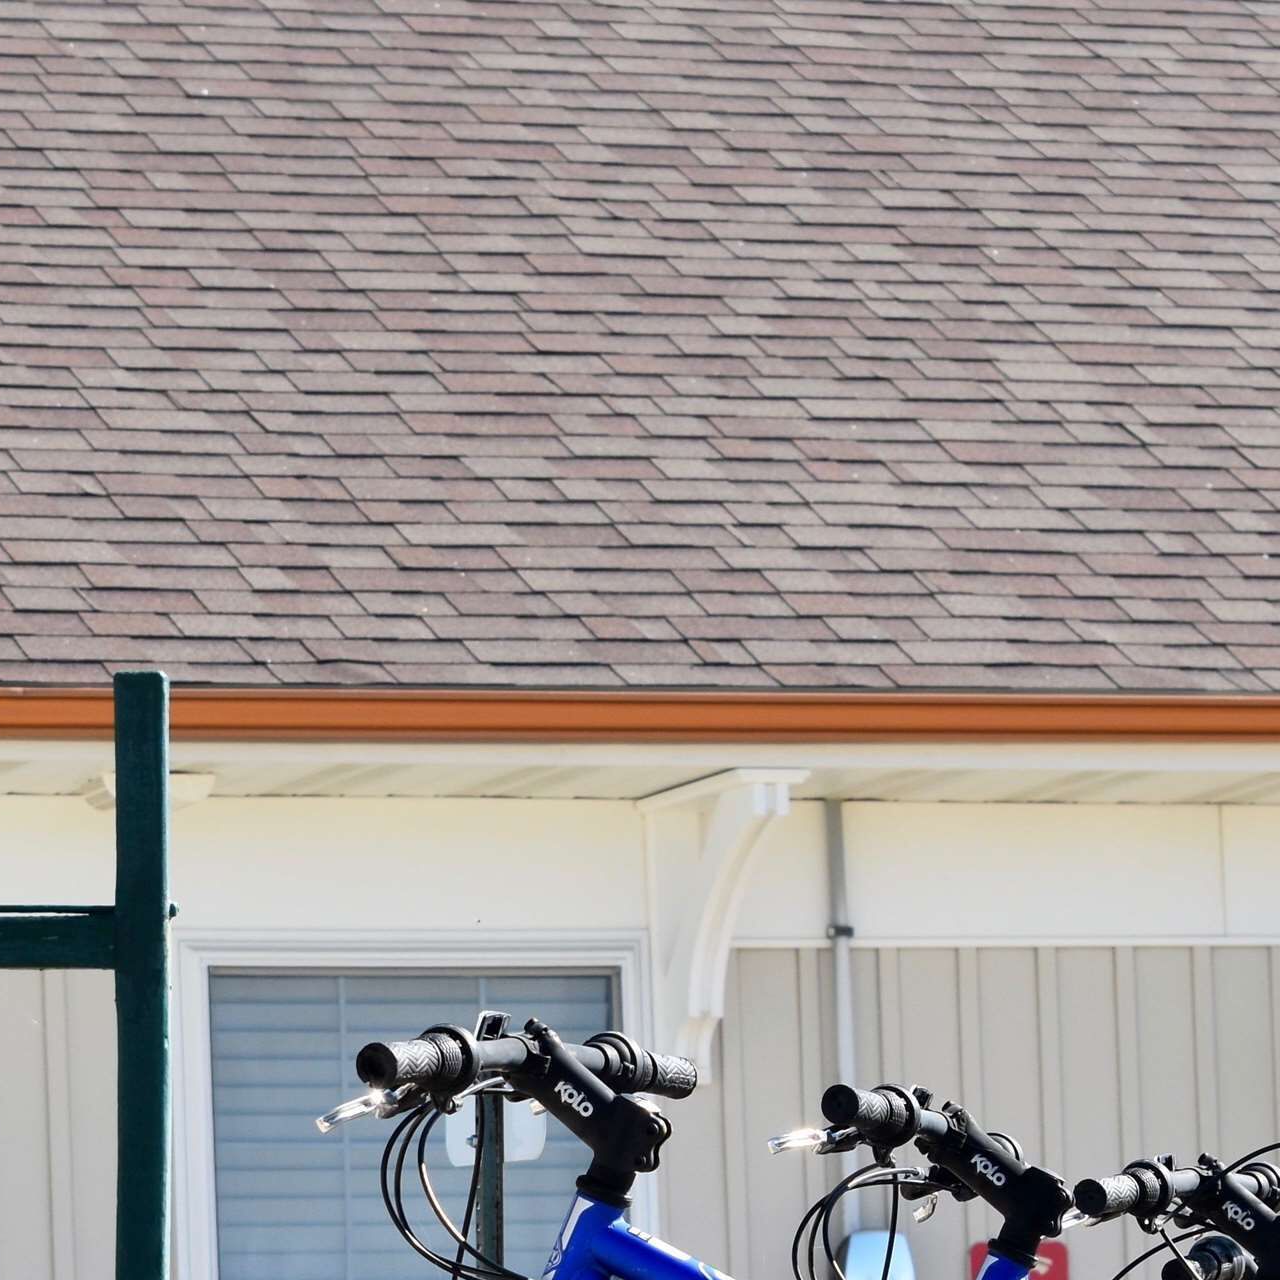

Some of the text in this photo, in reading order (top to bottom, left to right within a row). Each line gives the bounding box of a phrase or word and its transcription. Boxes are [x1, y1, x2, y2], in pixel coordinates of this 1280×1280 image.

[554, 1081, 594, 1118] KOLO
[970, 1153, 1007, 1187] KOLO
[1222, 1200, 1256, 1232] KOLO
